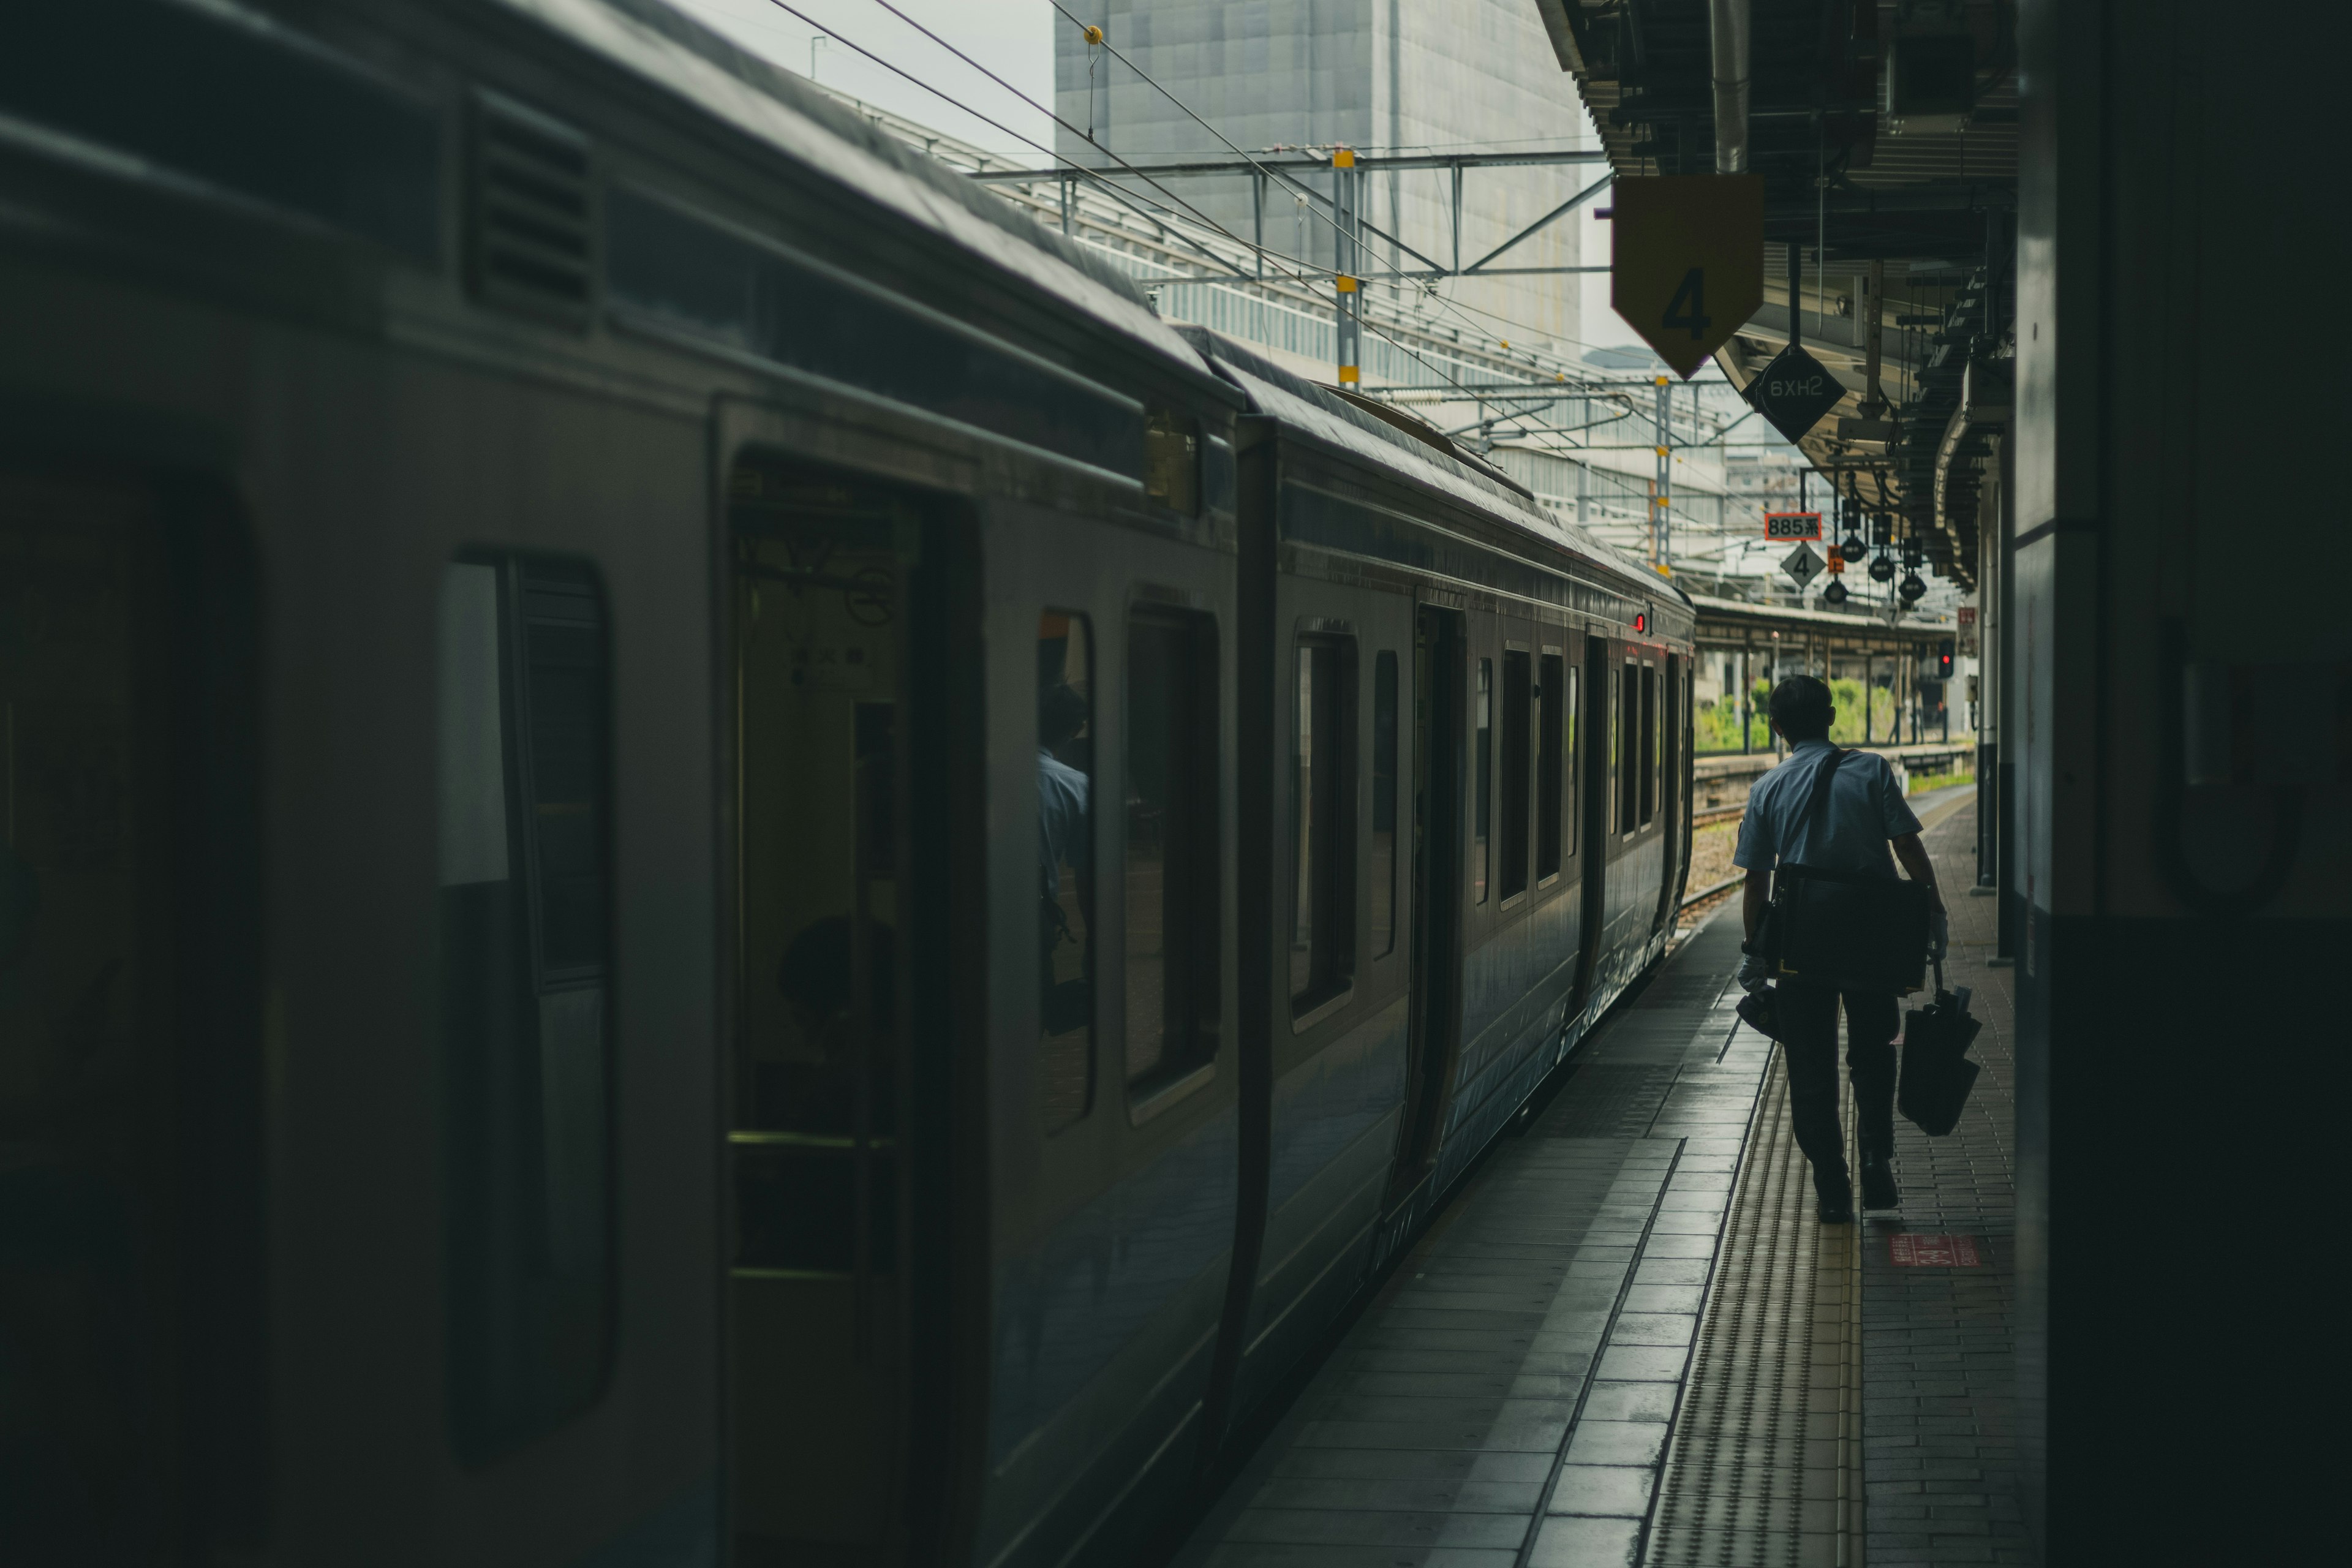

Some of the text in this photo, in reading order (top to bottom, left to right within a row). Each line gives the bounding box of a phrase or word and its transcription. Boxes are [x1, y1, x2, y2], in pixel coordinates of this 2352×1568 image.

[1662, 267, 1712, 341] 4
[1770, 375, 1823, 397] 6XH2
[1768, 518, 1819, 535] 885系
[1793, 552, 1810, 577] 4
[1888, 608, 1898, 623] 7
